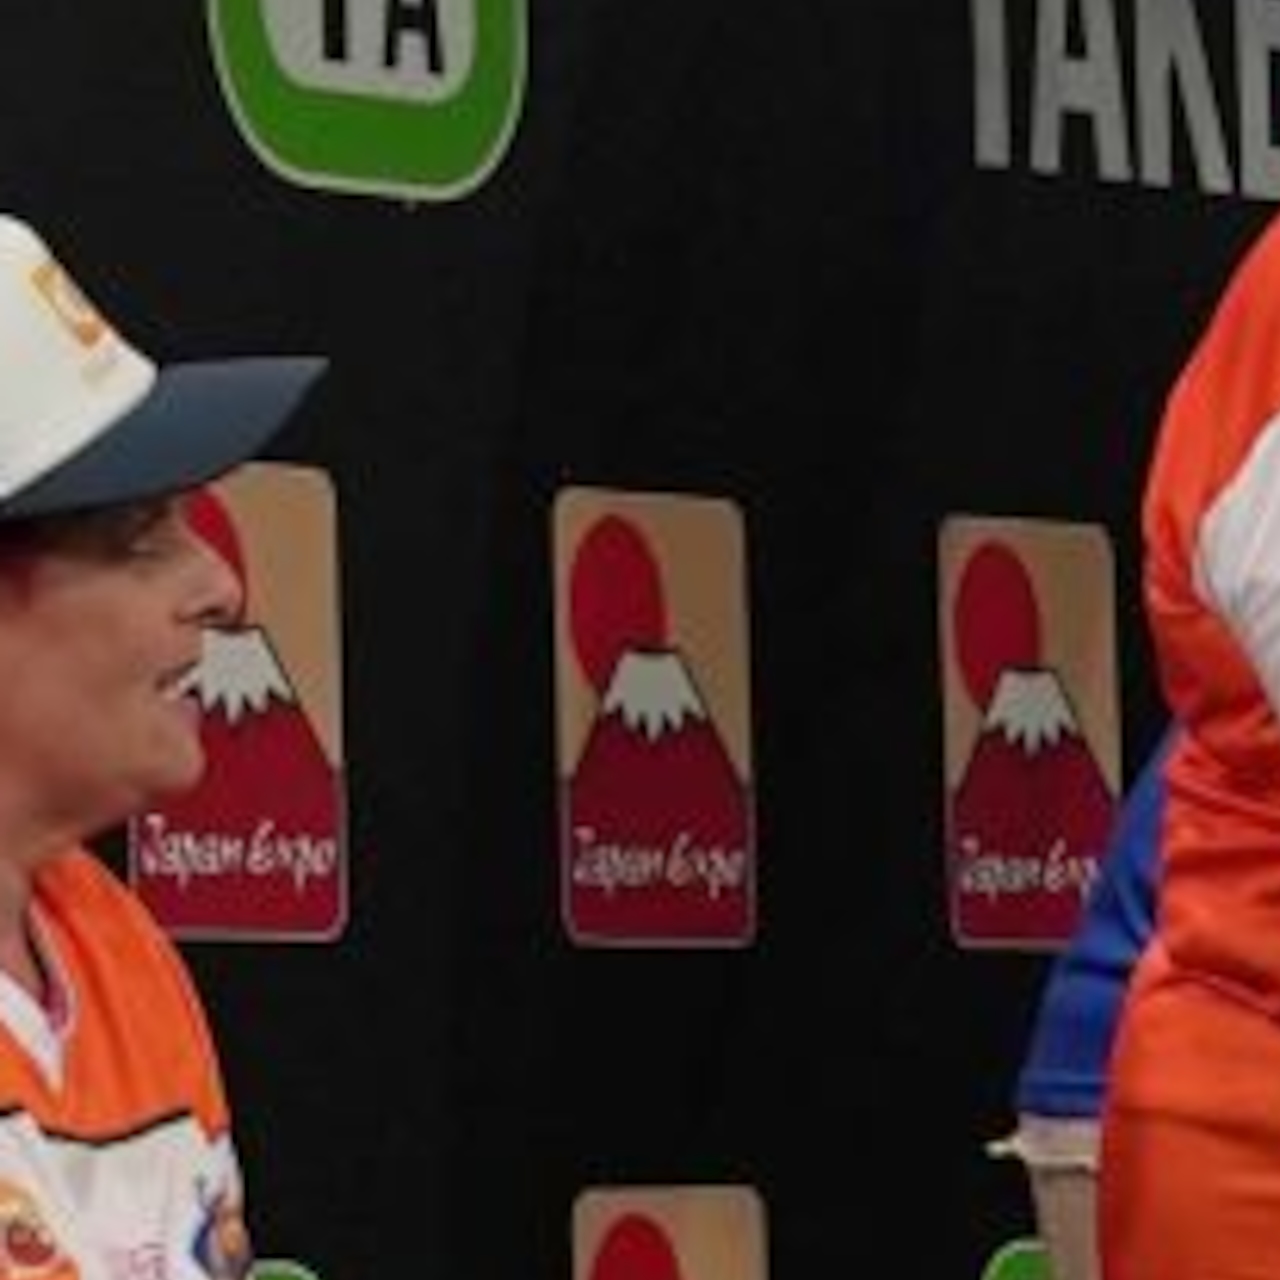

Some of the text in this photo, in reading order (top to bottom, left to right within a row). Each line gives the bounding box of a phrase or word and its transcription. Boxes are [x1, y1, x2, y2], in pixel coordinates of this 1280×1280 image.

[140, 814, 338, 894] Japan Expo
[572, 824, 664, 895] Japan
